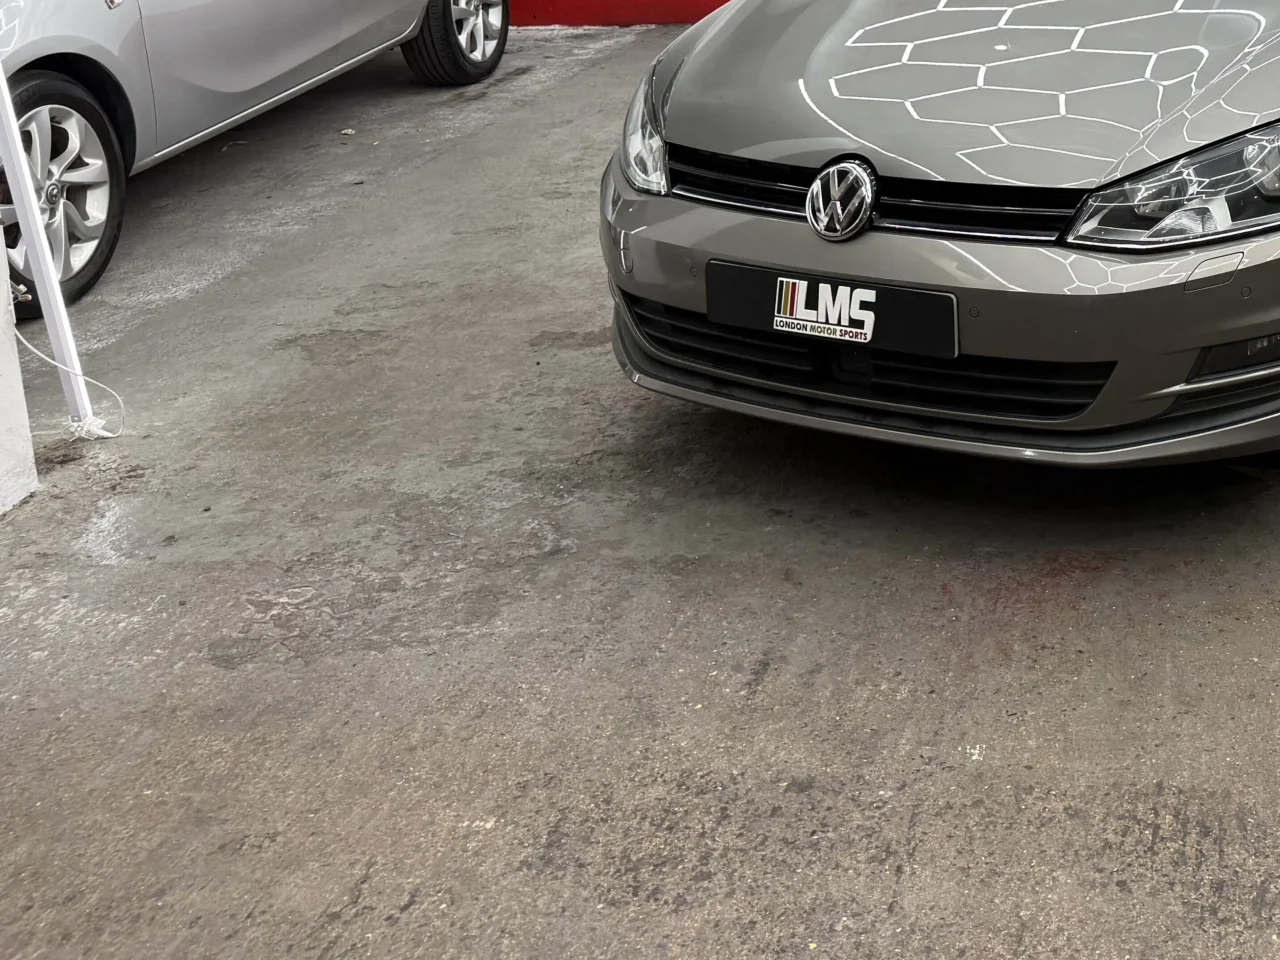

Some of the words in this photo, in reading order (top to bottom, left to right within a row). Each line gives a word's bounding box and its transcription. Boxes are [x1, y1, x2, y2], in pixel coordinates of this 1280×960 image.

[796, 280, 877, 338] LMS
[775, 319, 808, 331] LONDON
[809, 324, 838, 337] MOTOR
[839, 328, 868, 341] SPORTS
